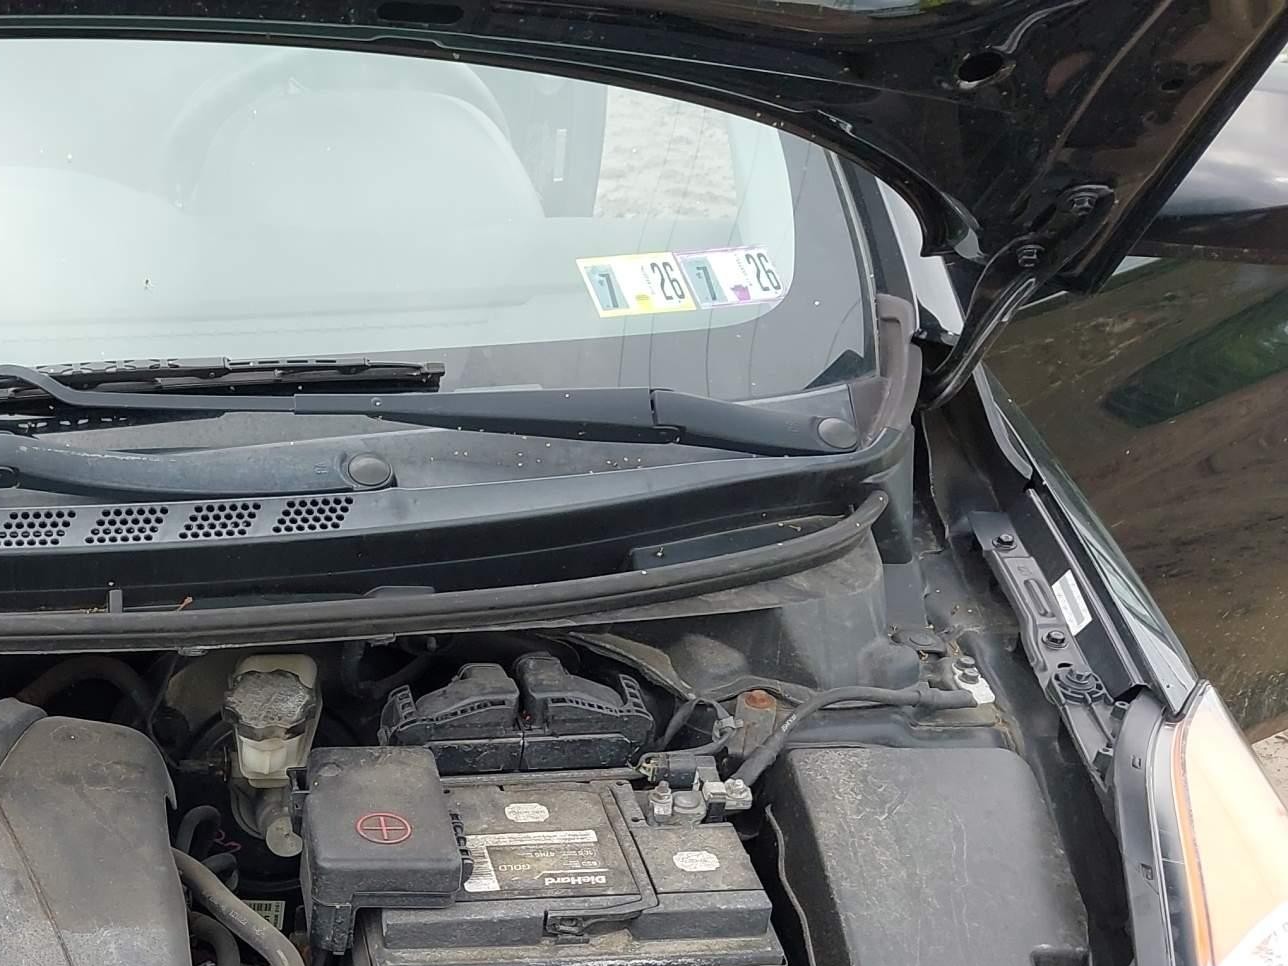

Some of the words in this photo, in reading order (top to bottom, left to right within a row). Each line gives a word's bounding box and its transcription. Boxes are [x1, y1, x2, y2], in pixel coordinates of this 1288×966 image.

[599, 273, 619, 309] 7
[651, 261, 686, 301] 26
[696, 265, 718, 302] 7
[745, 252, 782, 292] 26
[498, 863, 531, 872] GOLD
[544, 875, 607, 886] DieHard
